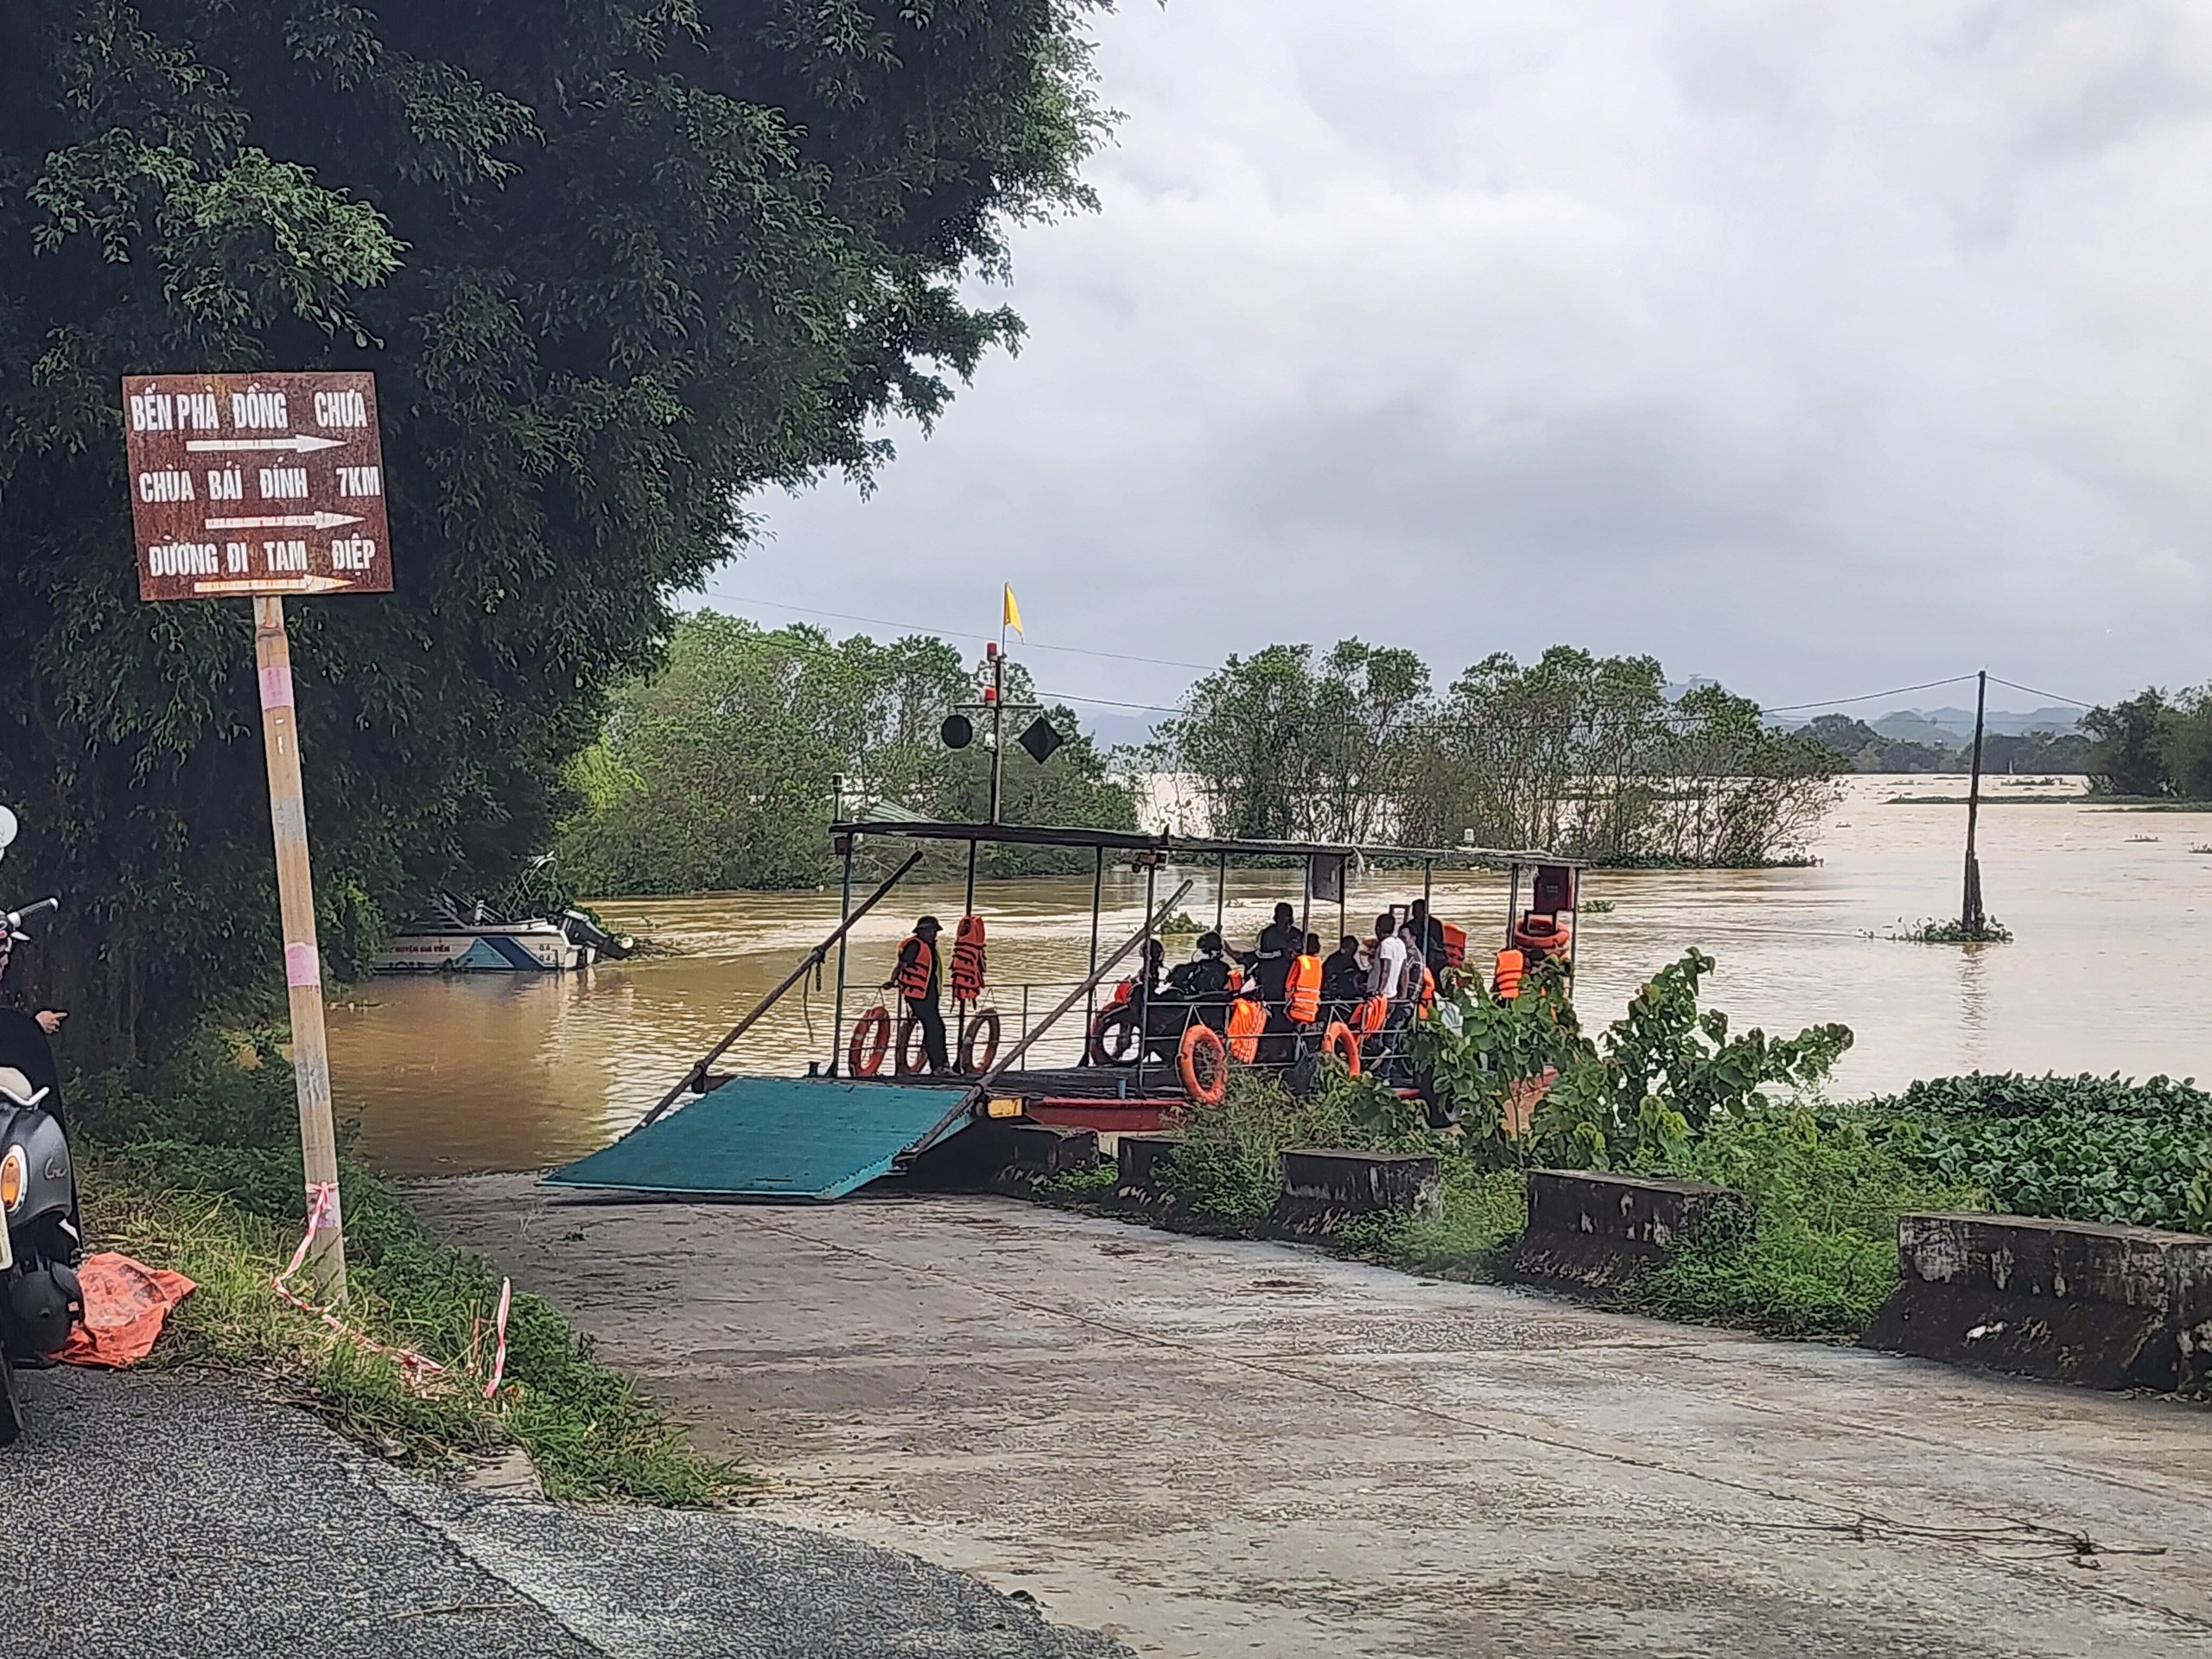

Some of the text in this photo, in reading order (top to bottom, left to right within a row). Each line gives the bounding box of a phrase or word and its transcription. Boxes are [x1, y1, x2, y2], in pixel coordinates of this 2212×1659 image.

[130, 382, 368, 431] BẾN PHÀ ĐỒNG CHƯA
[138, 463, 195, 503] CHÙA
[335, 467, 381, 498] 7KM
[149, 532, 376, 576] ĐƯỜNG ĐI TAM ĐIỆP
